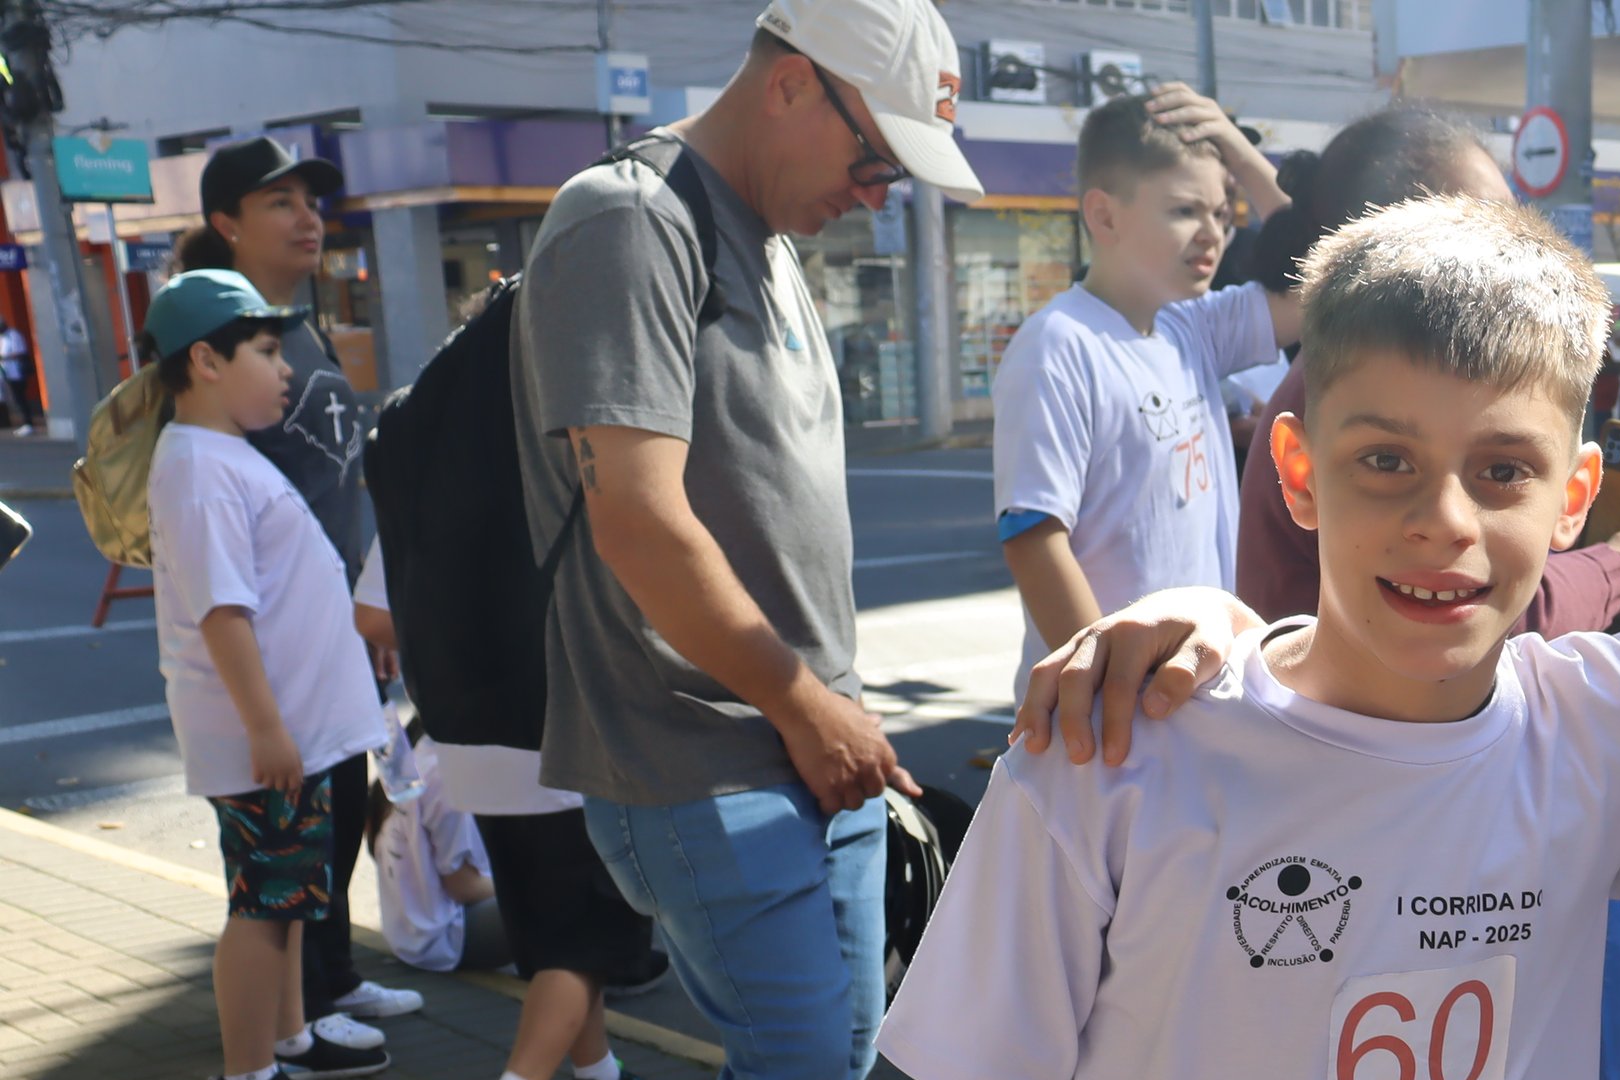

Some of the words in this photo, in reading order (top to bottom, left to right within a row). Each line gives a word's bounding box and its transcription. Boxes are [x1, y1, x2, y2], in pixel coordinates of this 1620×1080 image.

[1174, 431, 1209, 501] 75
[1240, 856, 1307, 891] APRENDIZAGEM
[1310, 859, 1342, 884] EMPATIA
[1236, 884, 1349, 914] ACOLHIMENTO
[1397, 896, 1403, 916] I
[1410, 892, 1515, 916] CORRIDA
[1233, 903, 1256, 957] DIVERSIDADE
[1261, 914, 1293, 956] RESPEITO
[1296, 915, 1322, 952] DIREITOS
[1329, 898, 1351, 945] PARCERIA
[1419, 929, 1467, 950] NAP
[1485, 922, 1532, 945] 2025
[1267, 953, 1317, 967] INCLUSÃO
